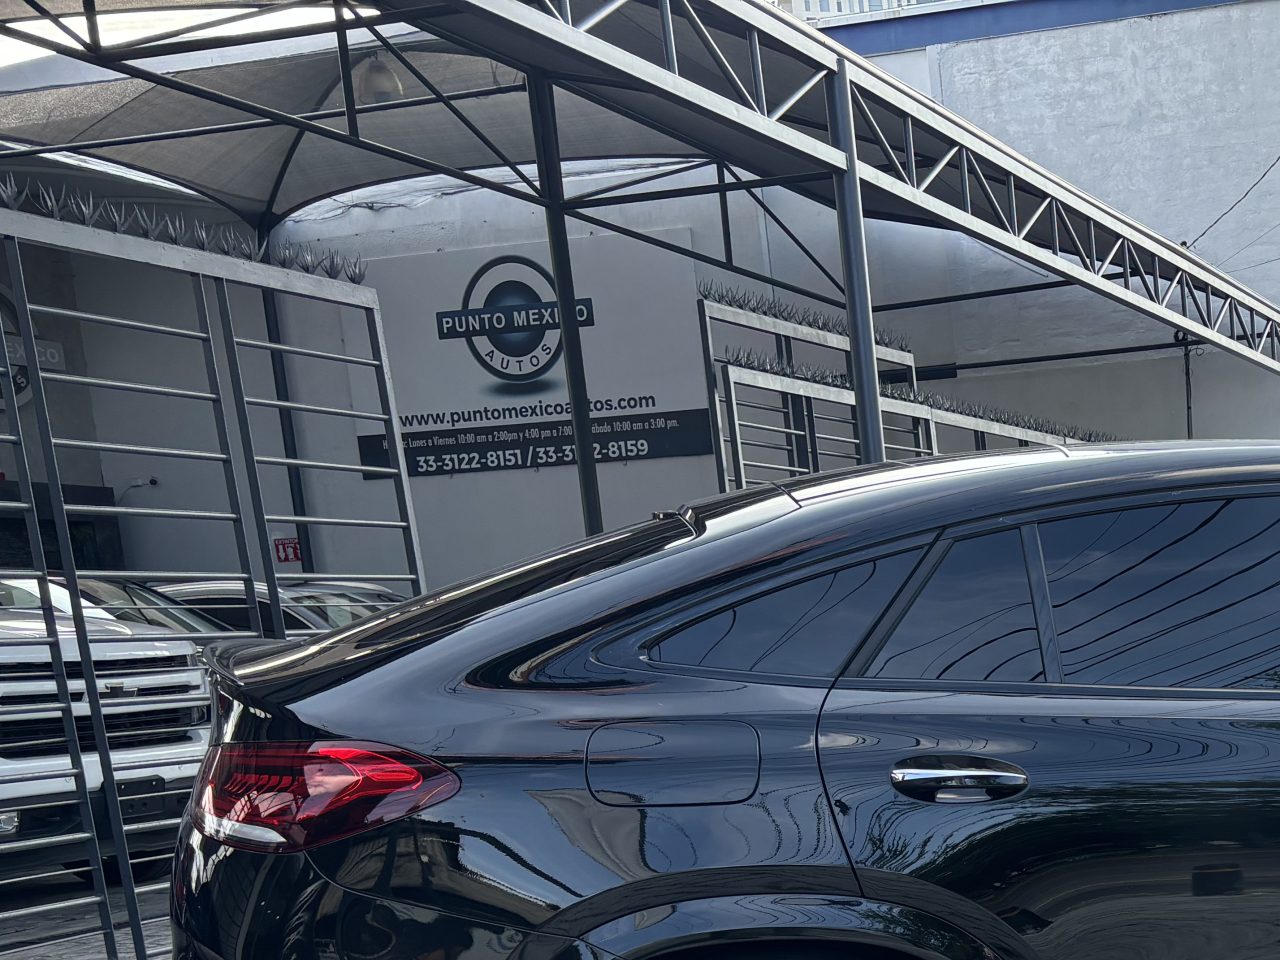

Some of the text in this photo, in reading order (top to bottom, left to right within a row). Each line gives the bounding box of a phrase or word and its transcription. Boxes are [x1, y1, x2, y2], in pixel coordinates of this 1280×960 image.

[442, 304, 588, 334] PUNTO MEXIO
[484, 342, 552, 372] AUTOS
[400, 394, 656, 427] www.puntomexicoatos.com
[409, 437, 427, 448] Lunes
[434, 434, 456, 447] Viernes
[457, 433, 475, 444] 10:00
[476, 434, 487, 443] am
[524, 428, 540, 439] 4:00
[541, 429, 551, 440] pm
[592, 422, 612, 434] ábado
[613, 421, 632, 432] 10:00
[633, 422, 644, 430] am
[650, 418, 665, 428] 3:00
[415, 448, 523, 472] 33-3122-8151
[536, 439, 649, 464] 33-312-8159
